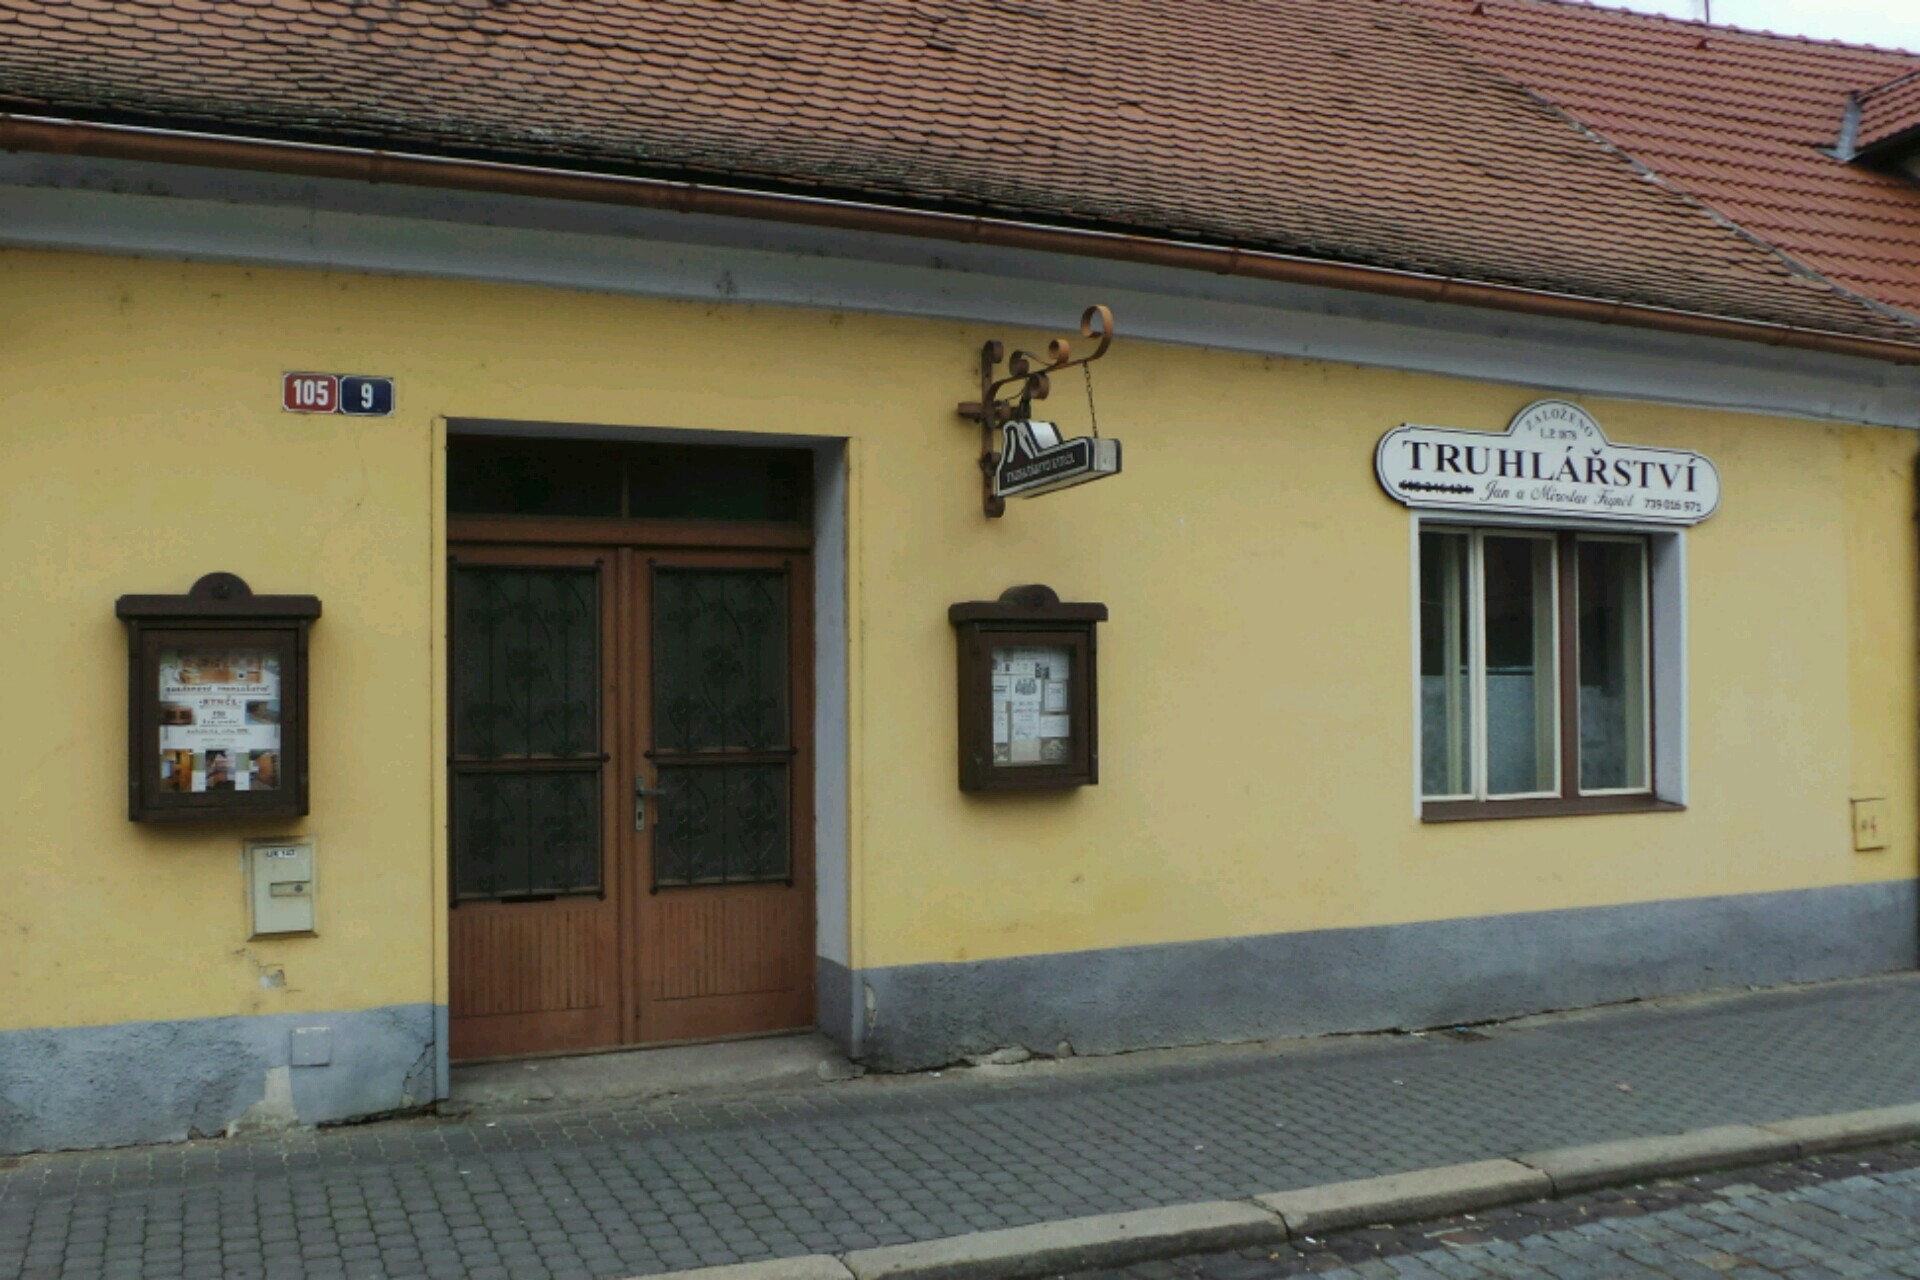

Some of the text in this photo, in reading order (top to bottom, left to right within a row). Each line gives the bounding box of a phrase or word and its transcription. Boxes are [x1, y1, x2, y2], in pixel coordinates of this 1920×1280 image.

[293, 379, 329, 406] 105
[361, 382, 373, 409] 9
[1525, 406, 1593, 437] ZALOŽENO
[1402, 440, 1698, 492] TRUHLÁŘSTVÍ
[1480, 480, 1510, 501] Jan
[1516, 489, 1524, 499] a
[1531, 484, 1588, 504] Miroslav
[1644, 498, 1662, 510] 739
